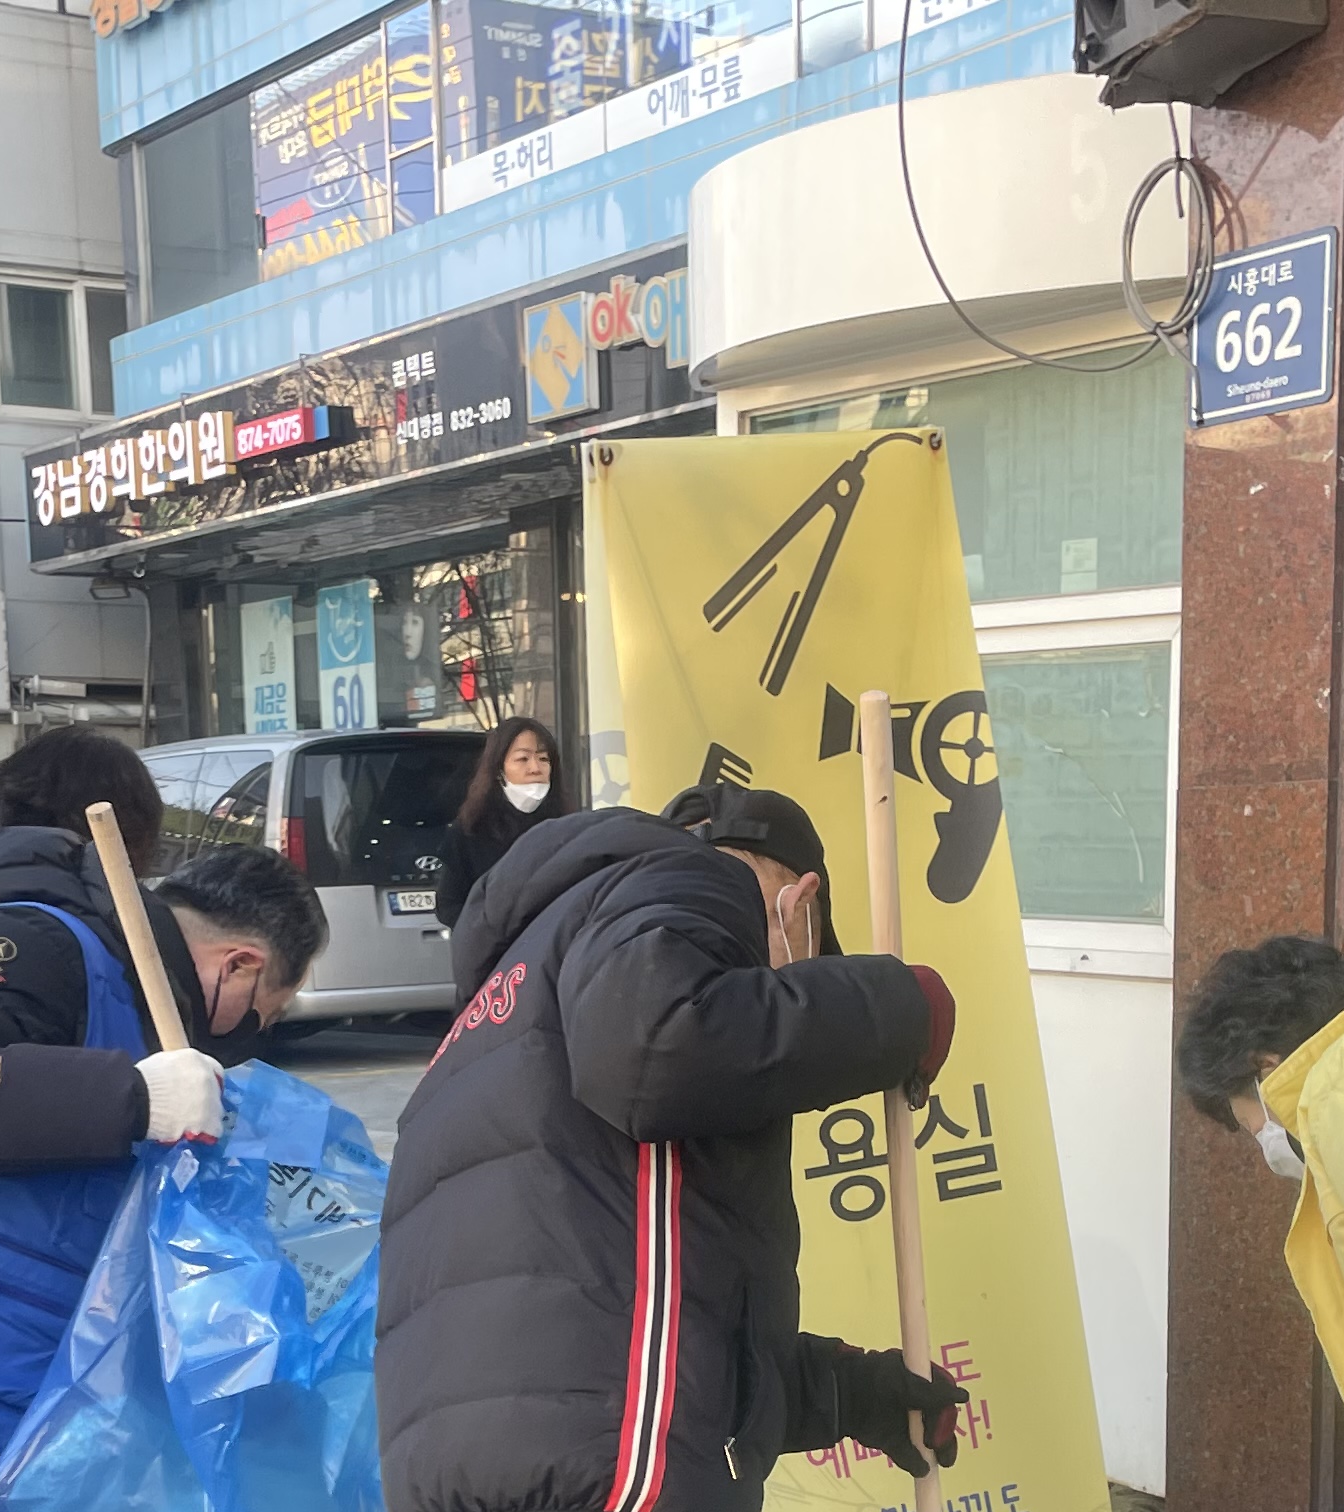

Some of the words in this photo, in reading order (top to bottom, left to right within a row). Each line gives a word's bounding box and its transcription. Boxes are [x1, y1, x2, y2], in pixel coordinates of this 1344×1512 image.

[647, 55, 744, 127] 어깨·무릎
[1227, 260, 1294, 296] 시흥대로
[1215, 296, 1303, 373] 662
[396, 412, 444, 445] 신대방점
[32, 411, 226, 526] 강남경희한의원
[237, 414, 303, 456] 874-7075
[333, 672, 365, 729] 60
